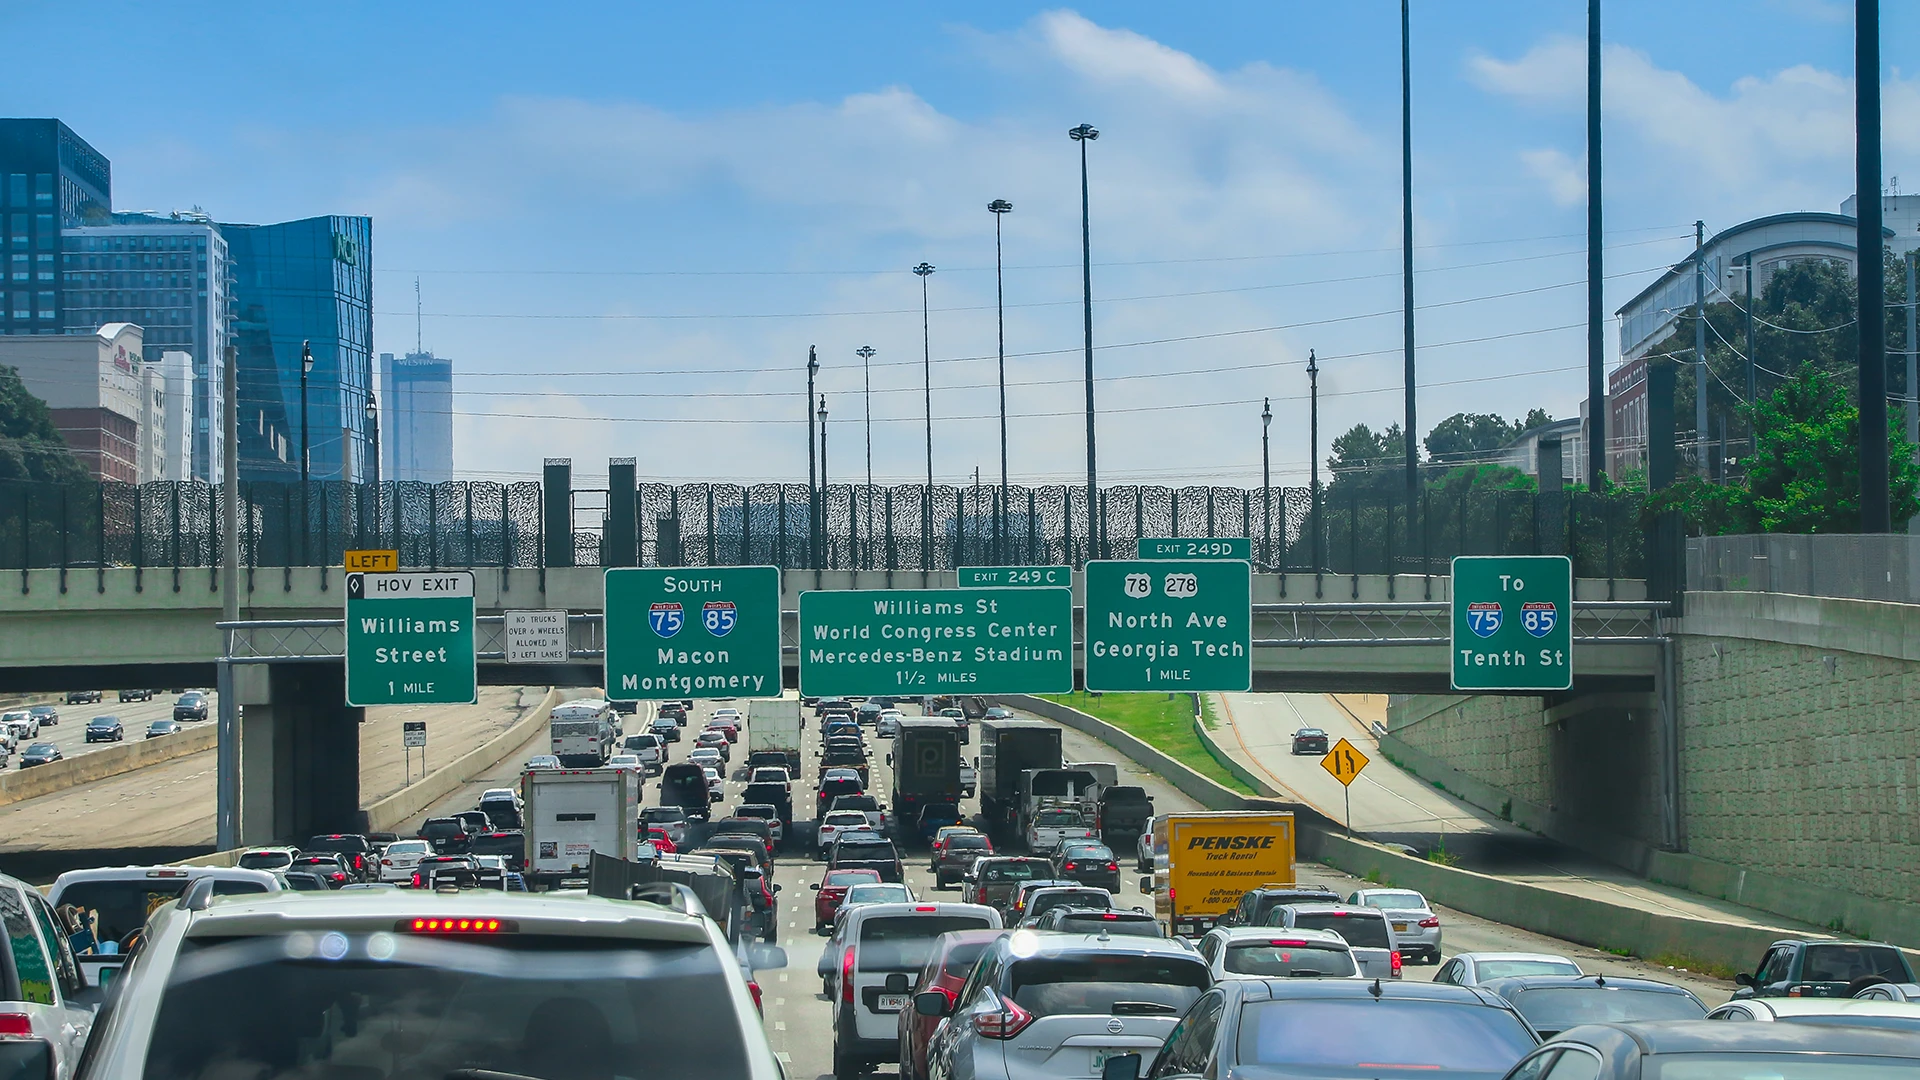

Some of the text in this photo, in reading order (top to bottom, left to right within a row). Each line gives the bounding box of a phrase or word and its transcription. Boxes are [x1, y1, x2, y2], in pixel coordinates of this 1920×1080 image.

[1157, 543, 1232, 556] EXIT 249D
[350, 554, 391, 568] LEFT
[377, 577, 459, 592] HOV EXIT
[664, 576, 722, 593] SOUTH
[974, 572, 998, 582] EXIT
[1127, 578, 1196, 593] 78 278
[1499, 575, 1525, 592] To
[874, 598, 998, 615] Williams St
[361, 617, 460, 634] Williams
[517, 615, 557, 624] NO TRUCKS
[653, 611, 681, 631] 75
[706, 610, 734, 630] 85
[1109, 611, 1227, 629] North Ave
[1470, 611, 1500, 631] 75
[1525, 611, 1554, 631] 85
[509, 627, 526, 635] OVER
[538, 626, 564, 635] WHEELS
[814, 621, 1058, 644] World Congress Center
[516, 638, 559, 647] ALLOWED IN
[1093, 640, 1244, 661] Georgia Tech
[375, 647, 447, 664] Street
[512, 650, 563, 659] 3 LEFT LANES
[658, 648, 729, 665] Macon
[810, 646, 1063, 664] Mercedes-Benz Stadium
[1460, 649, 1563, 666] Tenth St
[938, 672, 977, 683] MILES
[1145, 667, 1191, 682] 1 MILE
[388, 680, 435, 696] 1 MILE
[622, 673, 765, 696] Montgomery
[1187, 835, 1277, 850] PENSKE
[1206, 851, 1258, 861] Truck Rental
[1187, 870, 1219, 878] Household
[1226, 869, 1254, 877] Business
